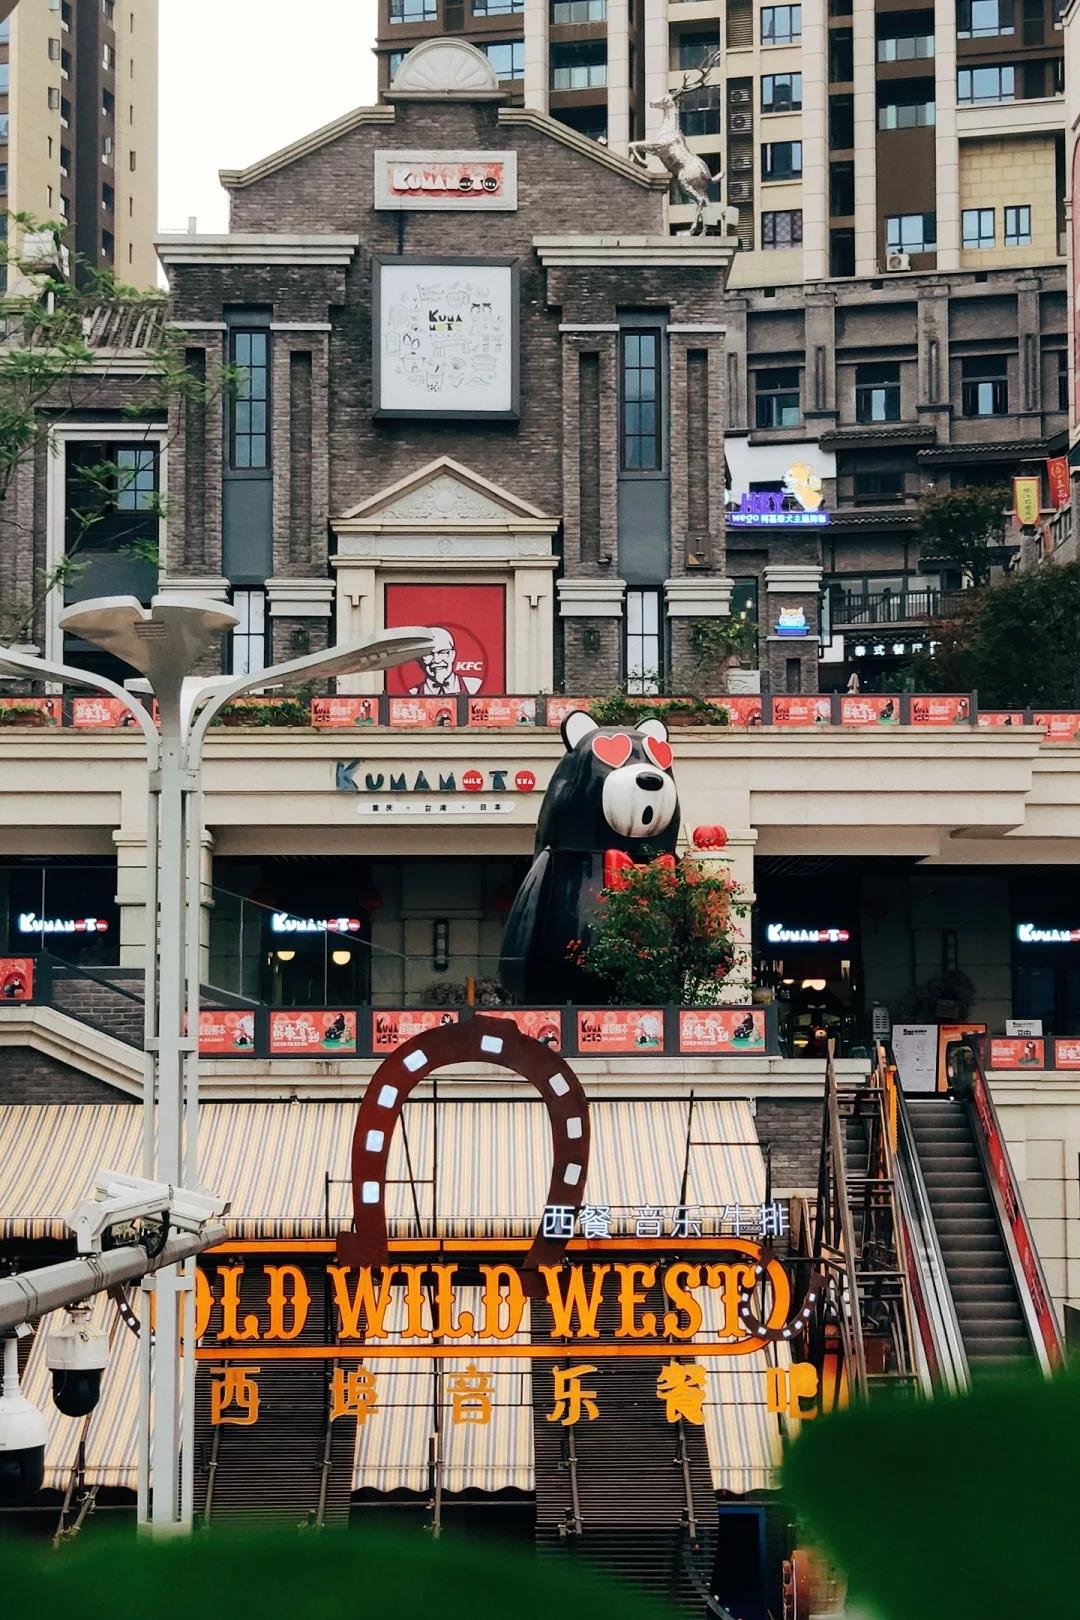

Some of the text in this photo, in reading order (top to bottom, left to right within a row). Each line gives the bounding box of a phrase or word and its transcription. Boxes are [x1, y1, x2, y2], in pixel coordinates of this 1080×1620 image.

[455, 661, 483, 671] KFC
[543, 1202, 791, 1239] 西餐 音乐 牛排
[326, 1264, 528, 1340] WILD
[539, 1262, 760, 1339] WEST
